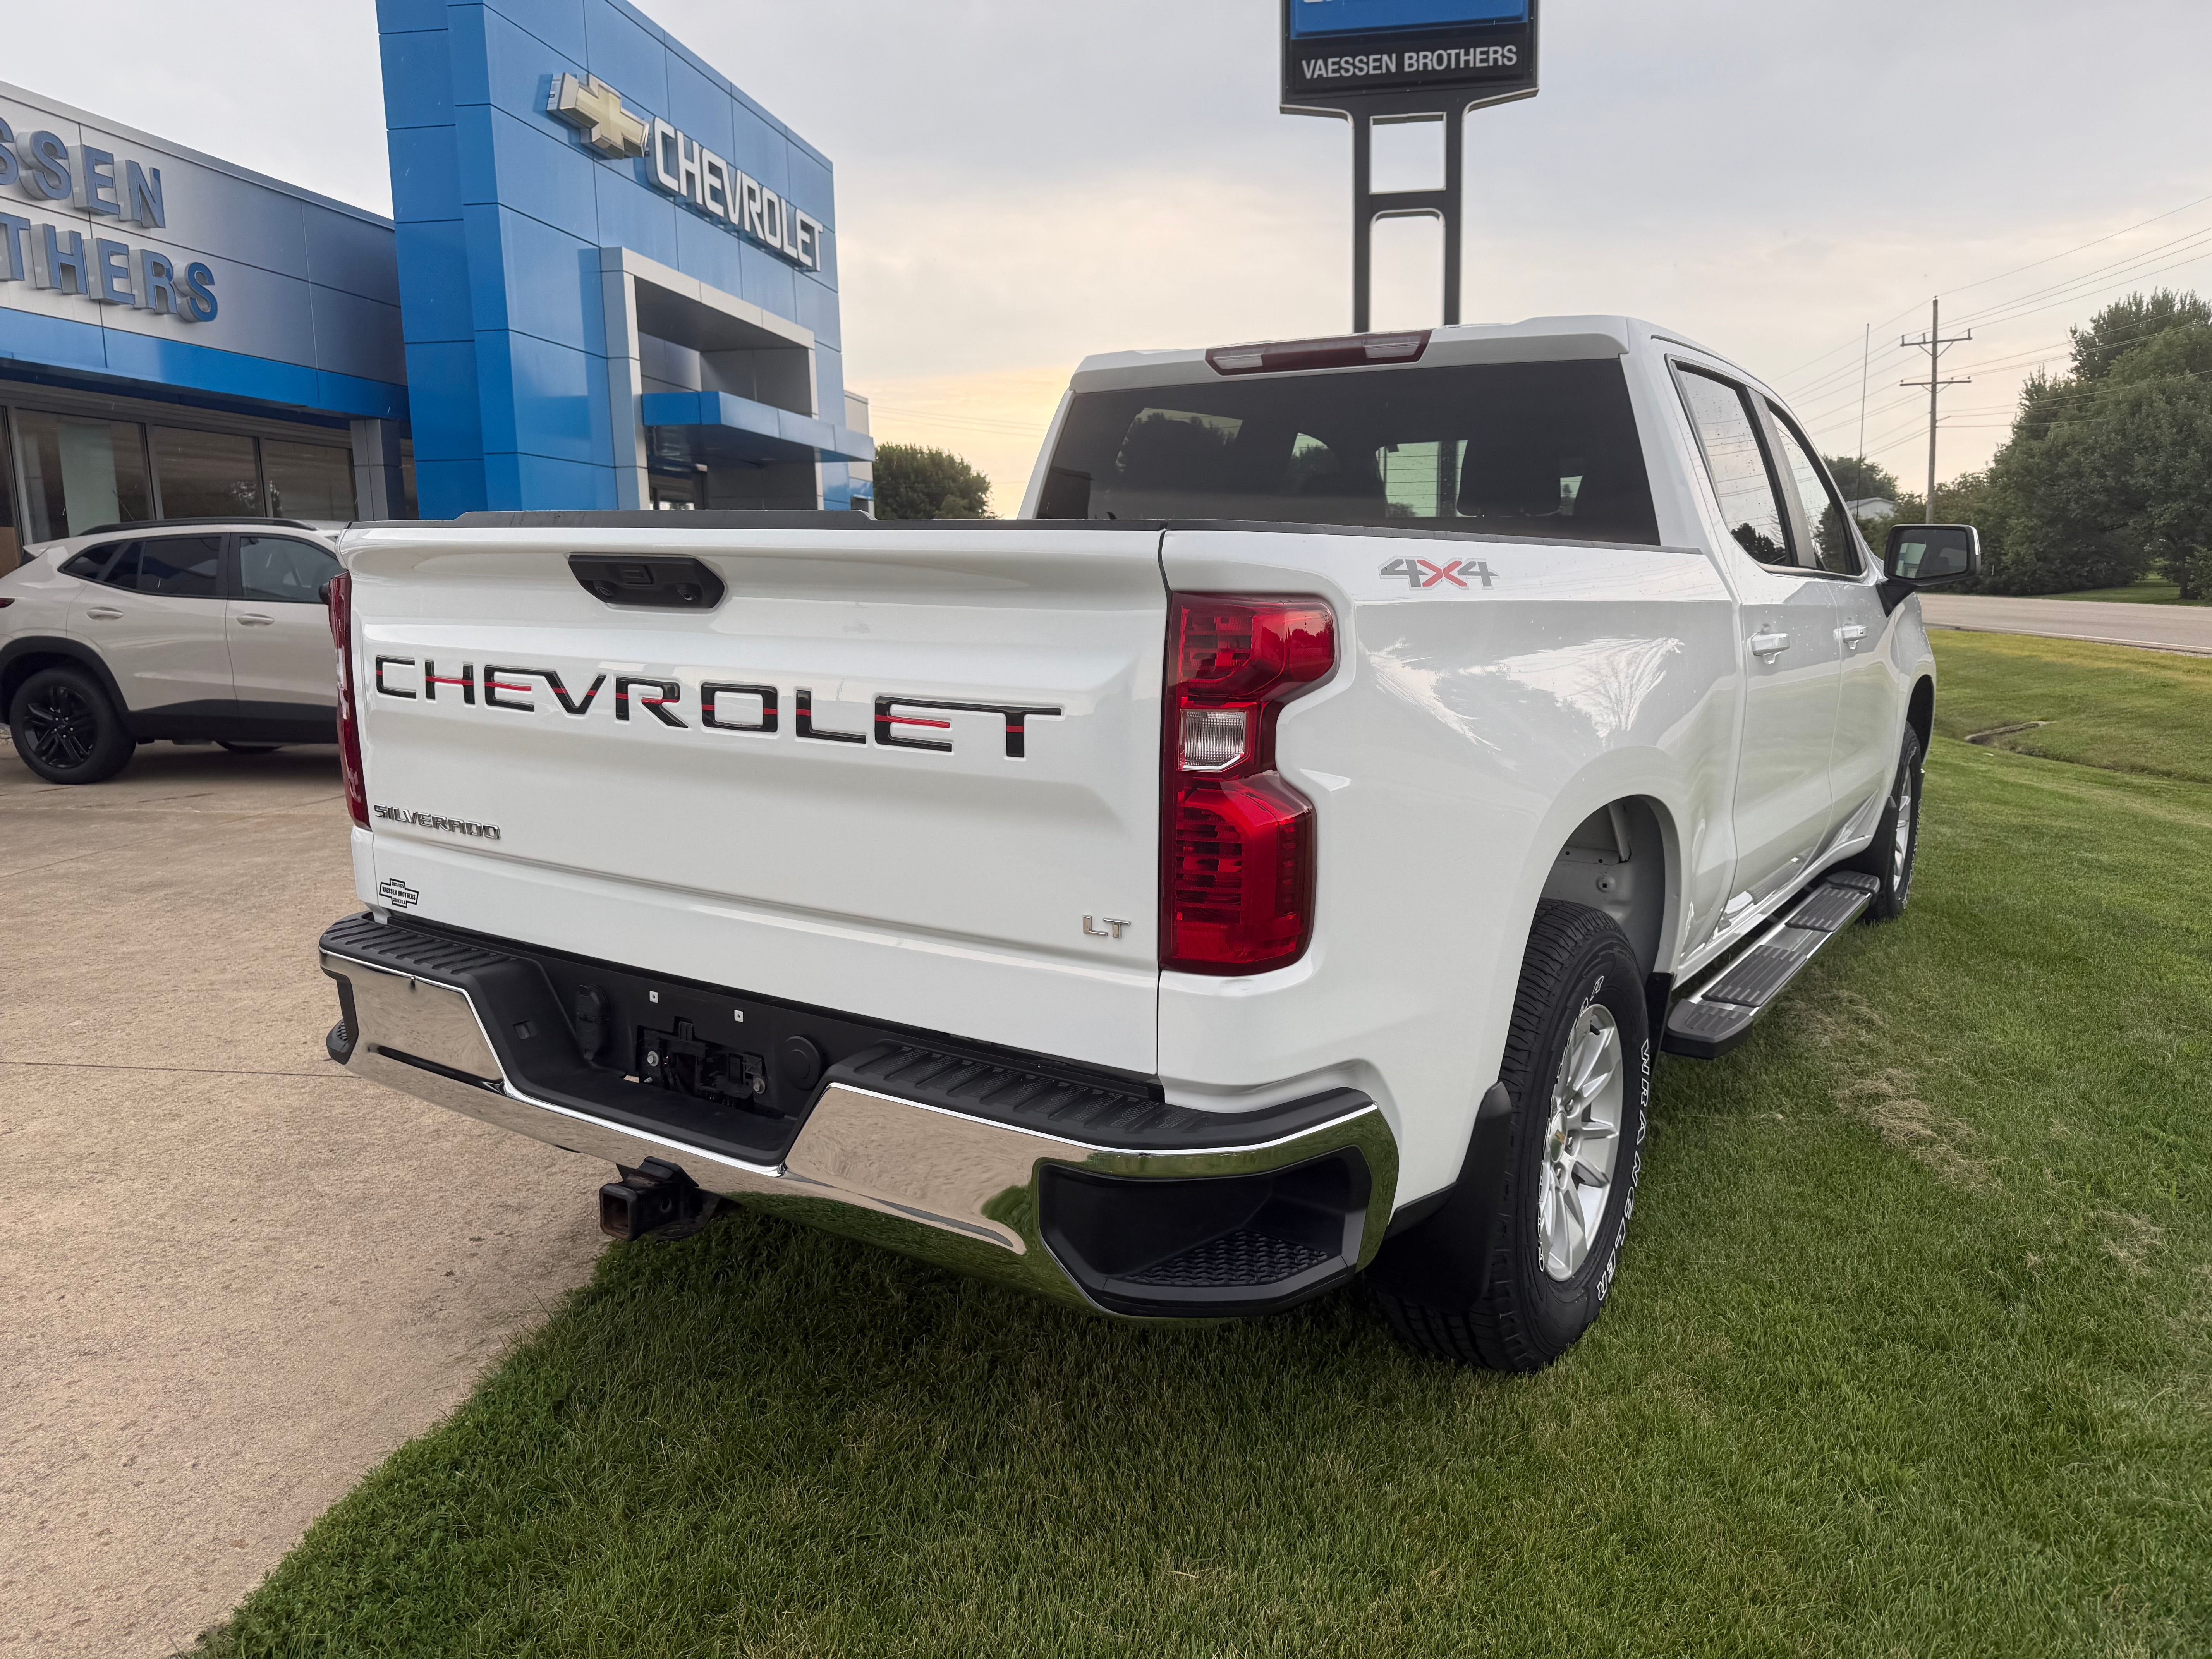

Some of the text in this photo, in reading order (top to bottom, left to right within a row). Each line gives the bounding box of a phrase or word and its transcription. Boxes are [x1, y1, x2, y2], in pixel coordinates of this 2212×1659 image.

[1302, 45, 1517, 79] VAESSEN BROTHERS
[649, 116, 823, 272] CHEVROLET
[0, 211, 218, 322] THERS
[1380, 559, 1499, 587] 4X4
[375, 655, 1062, 757] CHEVROLET
[374, 804, 501, 840] SILVERADO
[382, 886, 416, 900] VAESSEN BROTHERS
[1083, 915, 1131, 939] LT
[1597, 1038, 1650, 1301] WRANGLER
